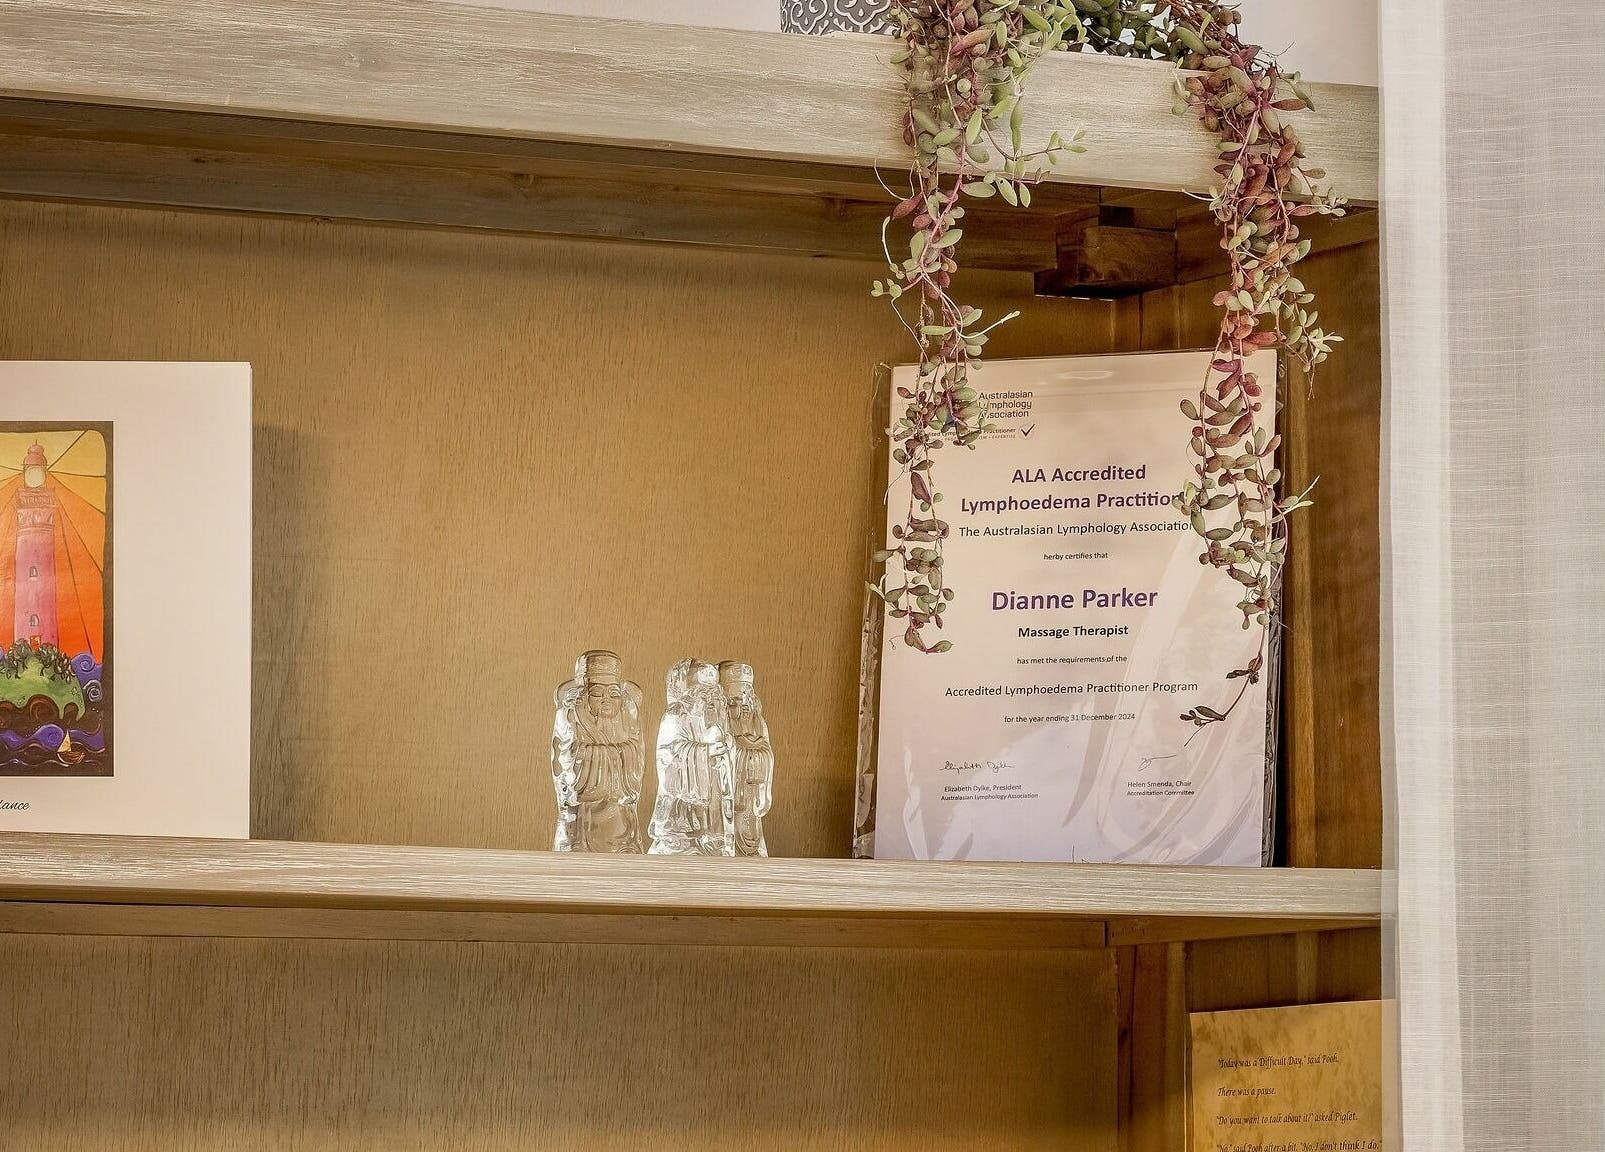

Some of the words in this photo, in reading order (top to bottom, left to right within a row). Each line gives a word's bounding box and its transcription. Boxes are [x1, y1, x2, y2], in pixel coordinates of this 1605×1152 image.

[979, 391, 1033, 400] Australasian
[978, 400, 1032, 410] Lmphology
[1011, 468, 1046, 483] ALA
[1051, 464, 1147, 482] Accredited
[961, 494, 1091, 515] Lymphoedema
[959, 526, 980, 537] The
[983, 524, 1053, 537] Australasian
[1057, 522, 1127, 536] Lymphology
[1043, 552, 1064, 562] herby
[1064, 552, 1093, 561] certifies
[1093, 551, 1109, 560] that
[992, 590, 1075, 611] Dianne
[1082, 588, 1158, 609] Parker
[1018, 626, 1070, 639] Massage
[1073, 625, 1129, 639] Therapist
[1016, 657, 1029, 665] has
[1045, 656, 1058, 664] the
[1059, 655, 1105, 665] requirements
[1105, 655, 1114, 663] of
[945, 685, 1002, 697] Accredited
[1005, 684, 1083, 697] Lymphoedema
[1086, 683, 1150, 694] Practitioner
[1152, 682, 1198, 695] Program
[1004, 715, 1014, 723] for
[1015, 715, 1027, 723] the
[1028, 716, 1044, 724] year
[1045, 714, 1070, 723] ending
[1080, 713, 1117, 722] December
[1118, 713, 1136, 721] 2024
[944, 785, 972, 793] Elizabeth
[992, 784, 1022, 792] President
[974, 793, 1007, 801] Lymphology
[1007, 792, 1039, 800] Association
[1307, 1054, 1321, 1065] said
[1217, 1086, 1236, 1097] There
[1237, 1088, 1250, 1096] was
[1250, 1088, 1256, 1096] a
[1228, 1116, 1242, 1128] you
[1242, 1116, 1260, 1125] want
[1261, 1116, 1269, 1125] to
[1269, 1113, 1283, 1125] talk
[1283, 1113, 1301, 1124] about
[1314, 1111, 1333, 1123] asked
[1339, 1139, 1360, 1150] think
